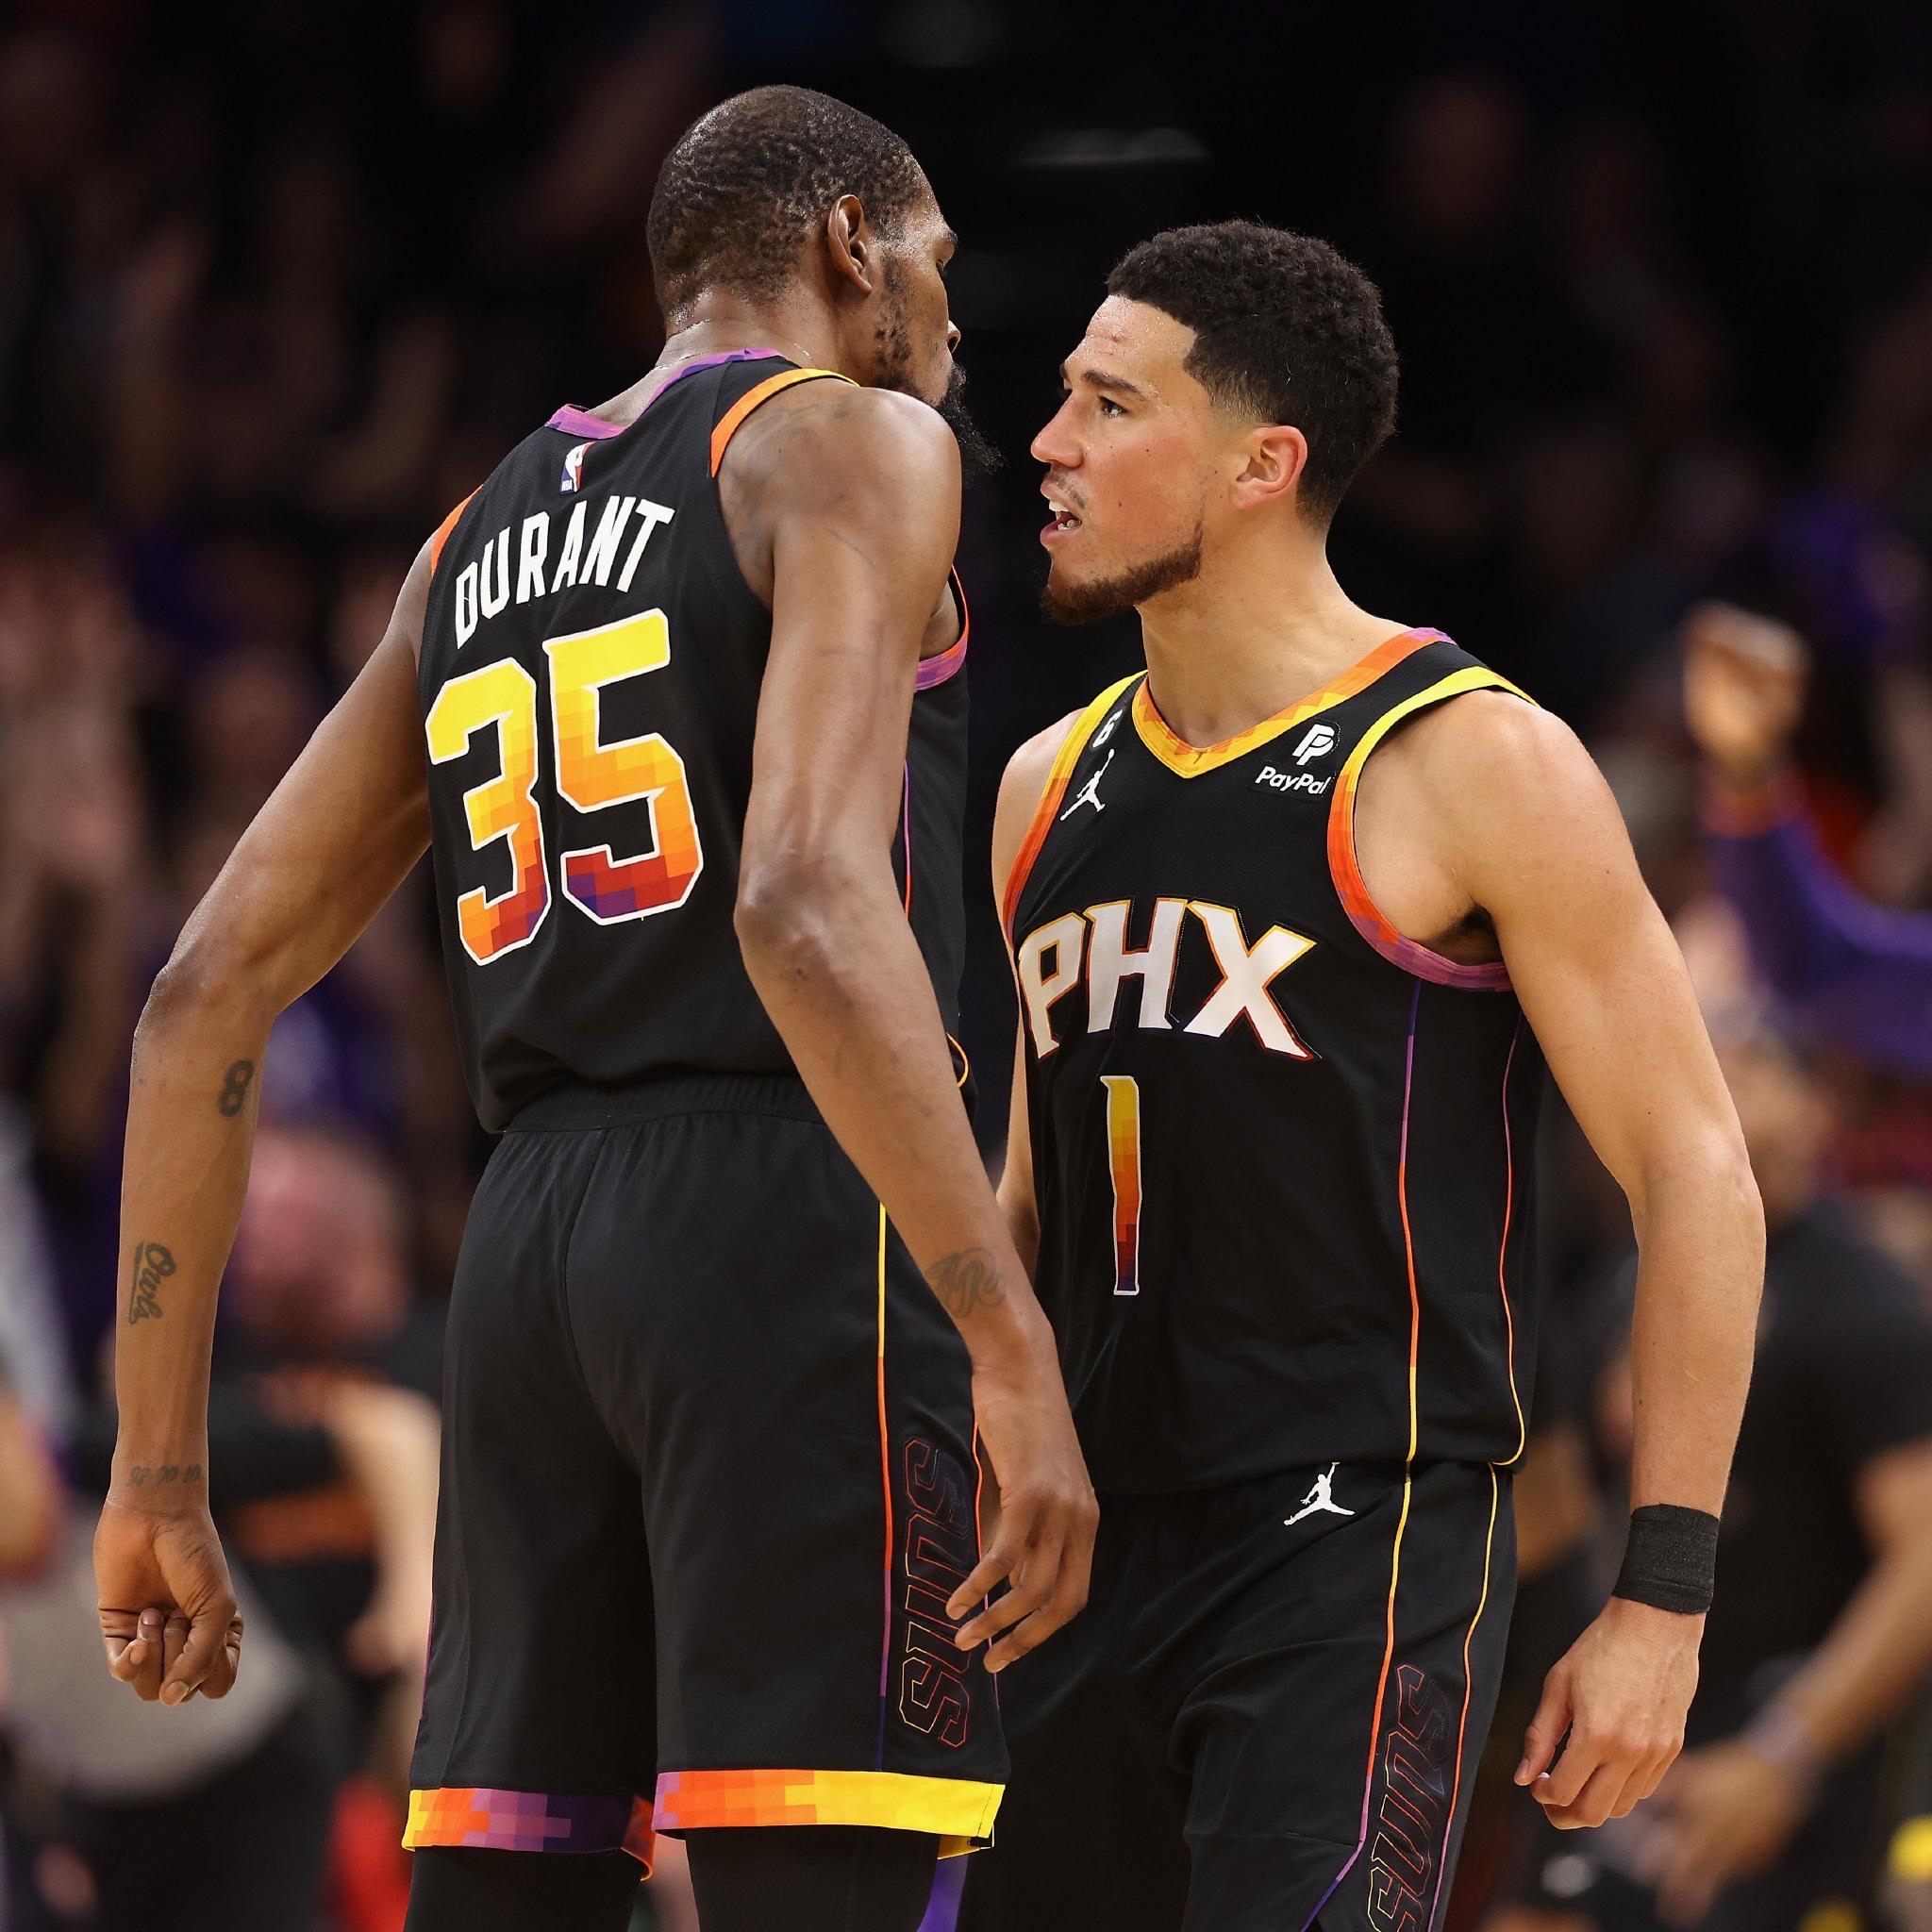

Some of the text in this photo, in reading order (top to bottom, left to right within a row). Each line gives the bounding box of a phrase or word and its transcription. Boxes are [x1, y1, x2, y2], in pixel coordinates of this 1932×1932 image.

[455, 495, 675, 650] DURANT
[425, 608, 704, 966] 35
[1092, 709, 1123, 748] 6
[1255, 766, 1331, 794] PayPal
[1019, 898, 1318, 1060] PHX
[1100, 1075, 1142, 1296] 1
[899, 1438, 971, 1749] SUNS
